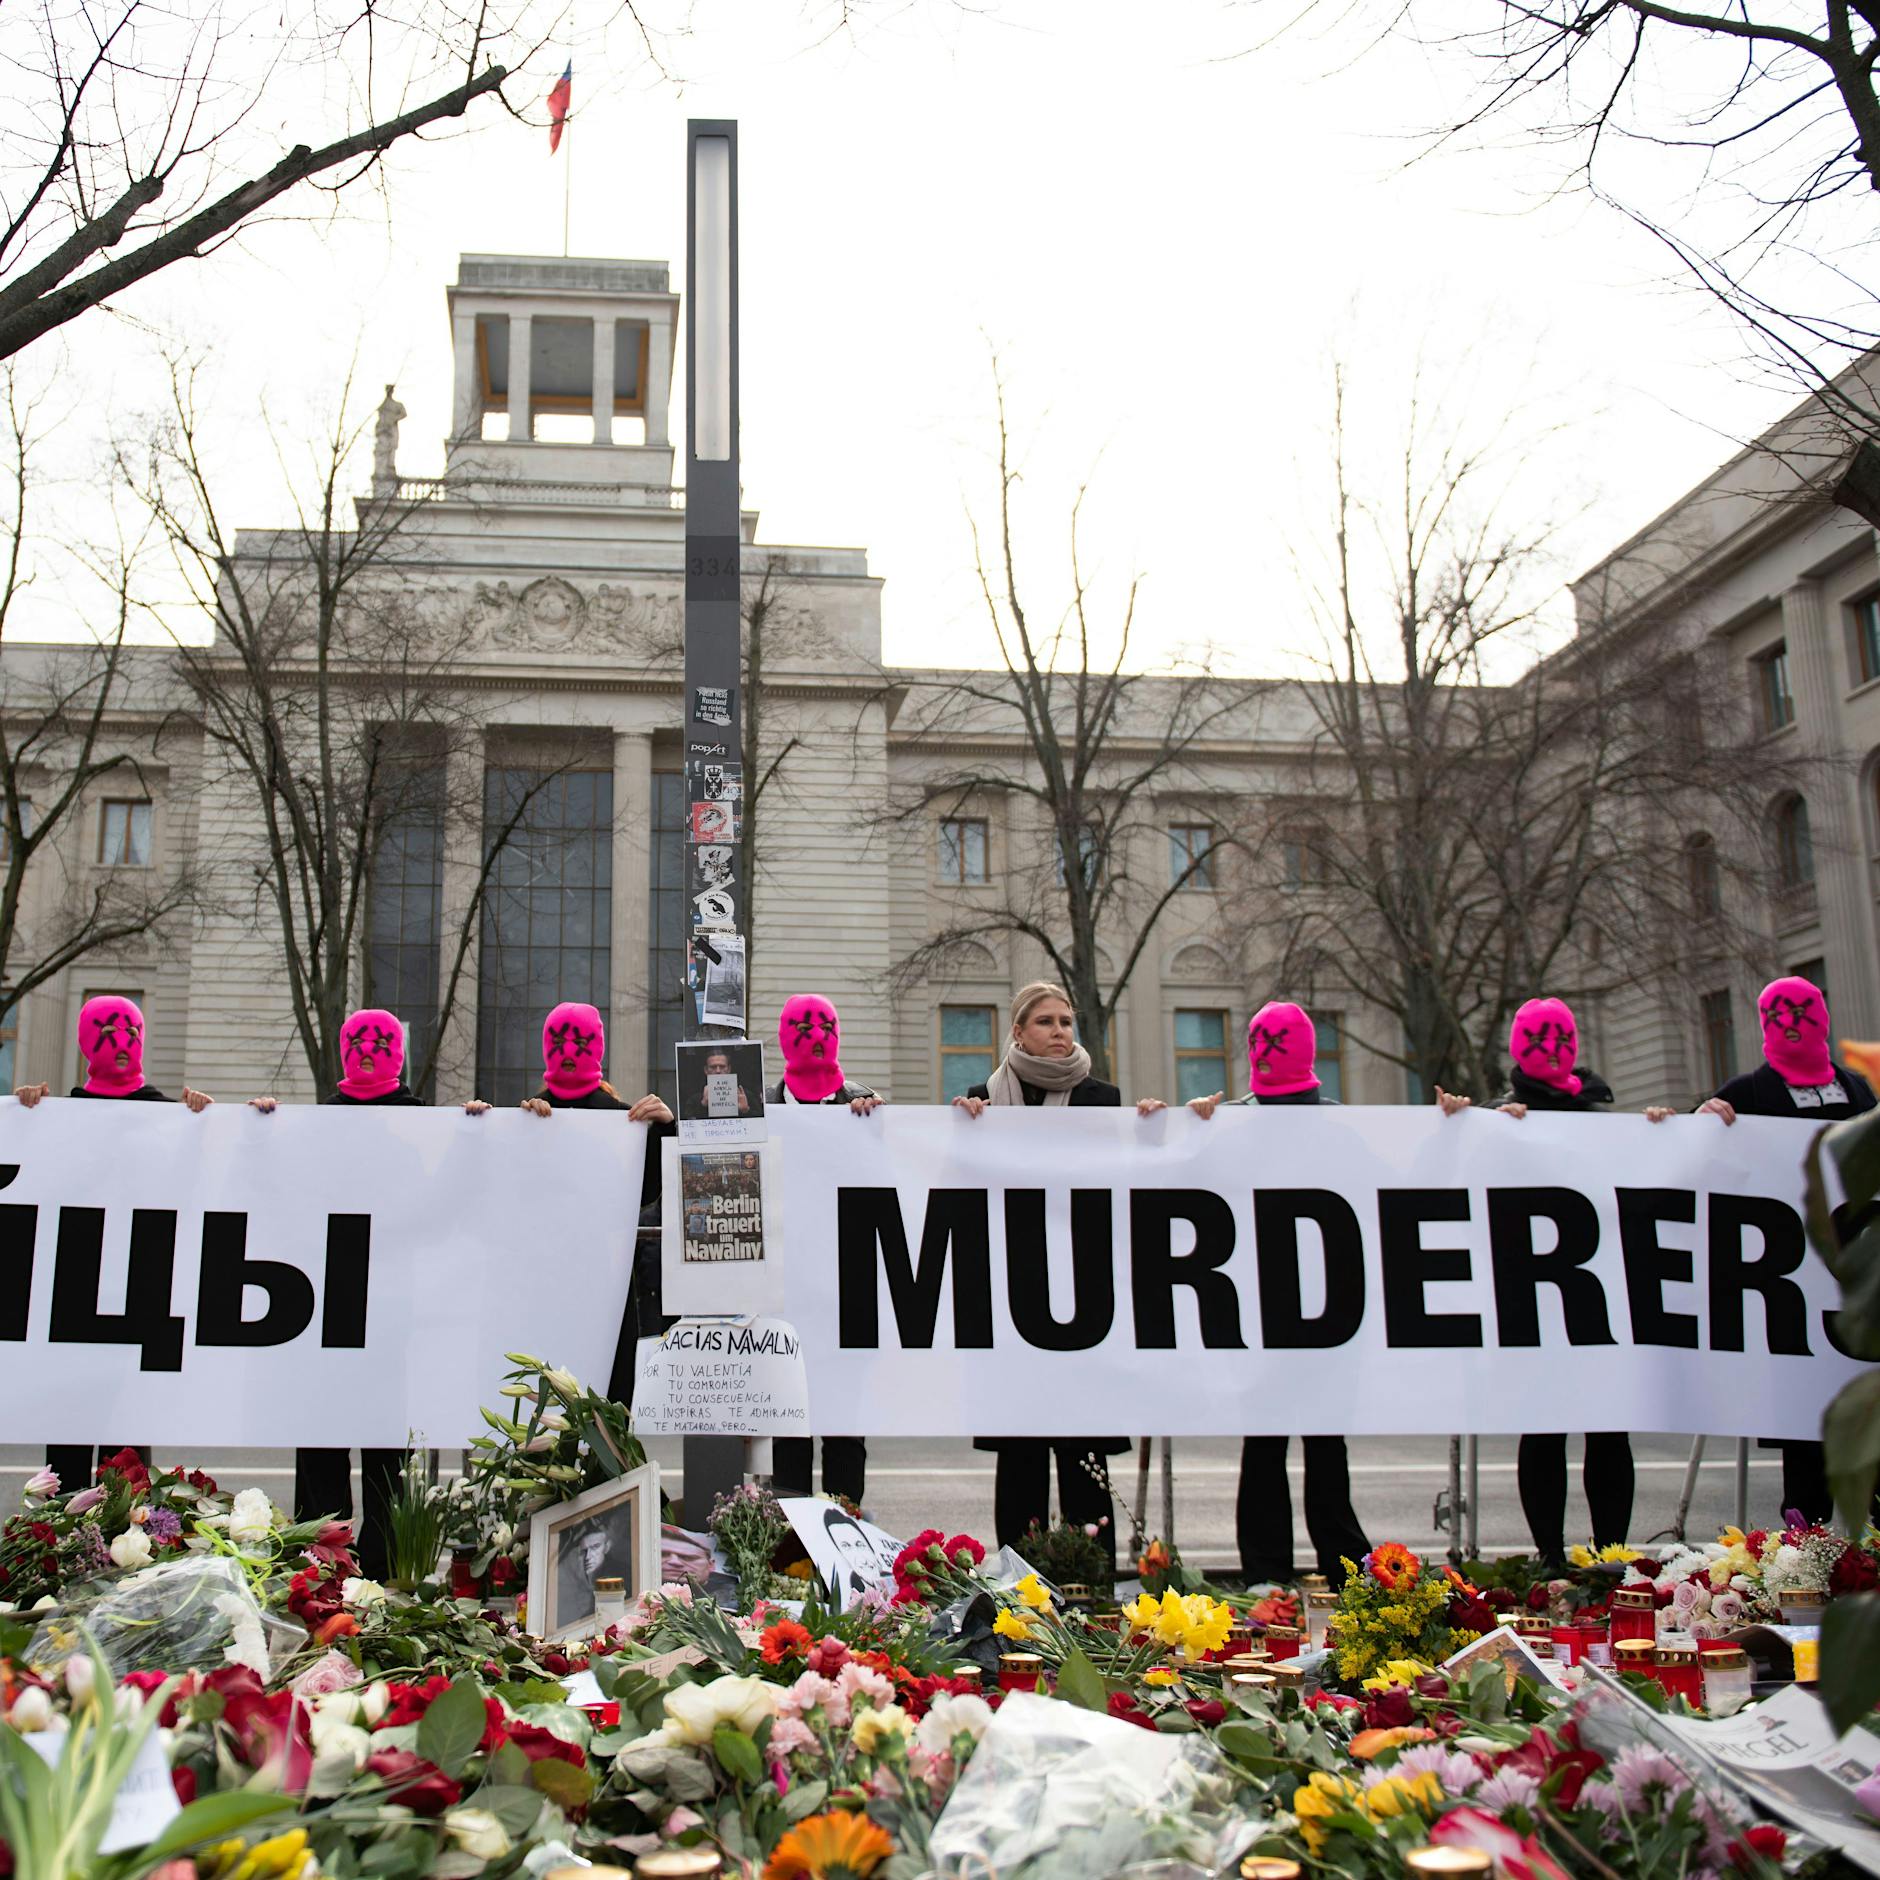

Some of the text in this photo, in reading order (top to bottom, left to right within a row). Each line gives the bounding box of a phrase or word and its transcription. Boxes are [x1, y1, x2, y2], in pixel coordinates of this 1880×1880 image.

[691, 557, 735, 577] 334
[702, 697, 727, 705] Russland
[708, 705, 727, 714] richtig
[712, 1194, 760, 1214] Berlin
[706, 1214, 761, 1233] trauert
[719, 1233, 734, 1243] um
[685, 1238, 761, 1261] Nawalny
[727, 1328, 800, 1360] NAWALNY
[668, 1364, 684, 1377] TU
[668, 1379, 683, 1390] TU
[668, 1393, 683, 1404] TU
[637, 1406, 657, 1418] NOS
[728, 1407, 744, 1417] TE
[654, 1421, 668, 1432] TE
